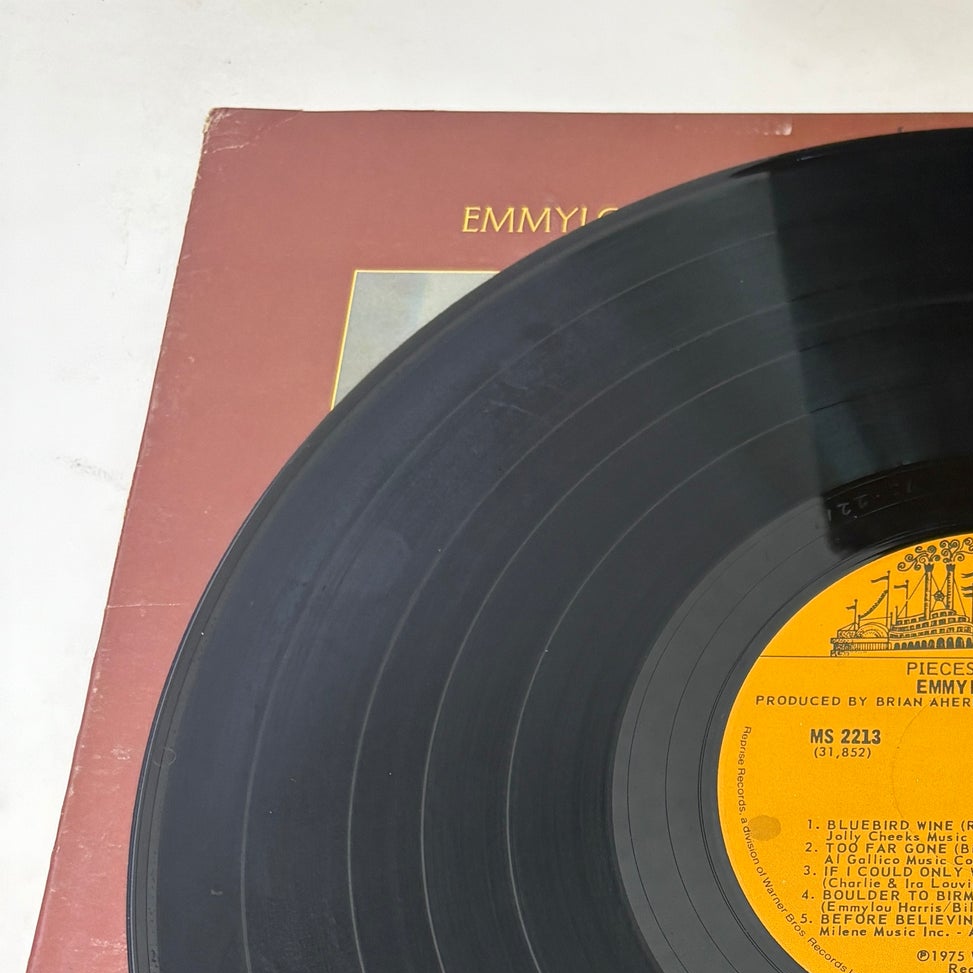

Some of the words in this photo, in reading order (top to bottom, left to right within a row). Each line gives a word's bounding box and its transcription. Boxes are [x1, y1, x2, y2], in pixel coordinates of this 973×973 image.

[462, 206, 618, 233] EMMYL
[755, 695, 841, 706] PRODUCED
[849, 697, 867, 706] BY
[876, 697, 923, 707] BRIAN
[810, 729, 834, 744] MS
[841, 729, 881, 744] 2213
[738, 726, 752, 766] Reprise
[813, 747, 872, 760] (31,852)
[807, 819, 820, 830] 1.
[827, 820, 910, 831] BLUEBIRD
[917, 820, 954, 831] WINE
[826, 831, 861, 844] Jolly
[868, 831, 920, 842] Cheeks
[927, 832, 967, 842] Music
[743, 826, 760, 865] division
[805, 842, 818, 853] 2.
[826, 843, 858, 853] TOO
[865, 843, 896, 853] FAR
[904, 843, 947, 854] GONE
[824, 854, 840, 864] Al
[847, 855, 900, 865] Gallico
[906, 855, 947, 865] Music
[756, 866, 768, 877] of
[803, 865, 817, 876] 3.
[824, 866, 838, 877] IF
[846, 866, 850, 877] I
[857, 866, 913, 877] COULD
[920, 866, 963, 877] ONLY
[822, 877, 881, 889] (Charlie
[887, 878, 897, 889] &
[905, 878, 924, 889] Ira
[763, 877, 788, 913] Warner
[801, 889, 815, 900] 4.
[822, 890, 900, 901] BOULDER
[908, 890, 929, 901] TO
[821, 901, 892, 914] (Emmylou
[800, 913, 813, 924] 5.
[821, 913, 888, 925] BEFORE
[819, 926, 867, 937] Milene
[874, 926, 916, 937] Music
[923, 927, 949, 937] Inc.
[807, 937, 848, 973] Records
